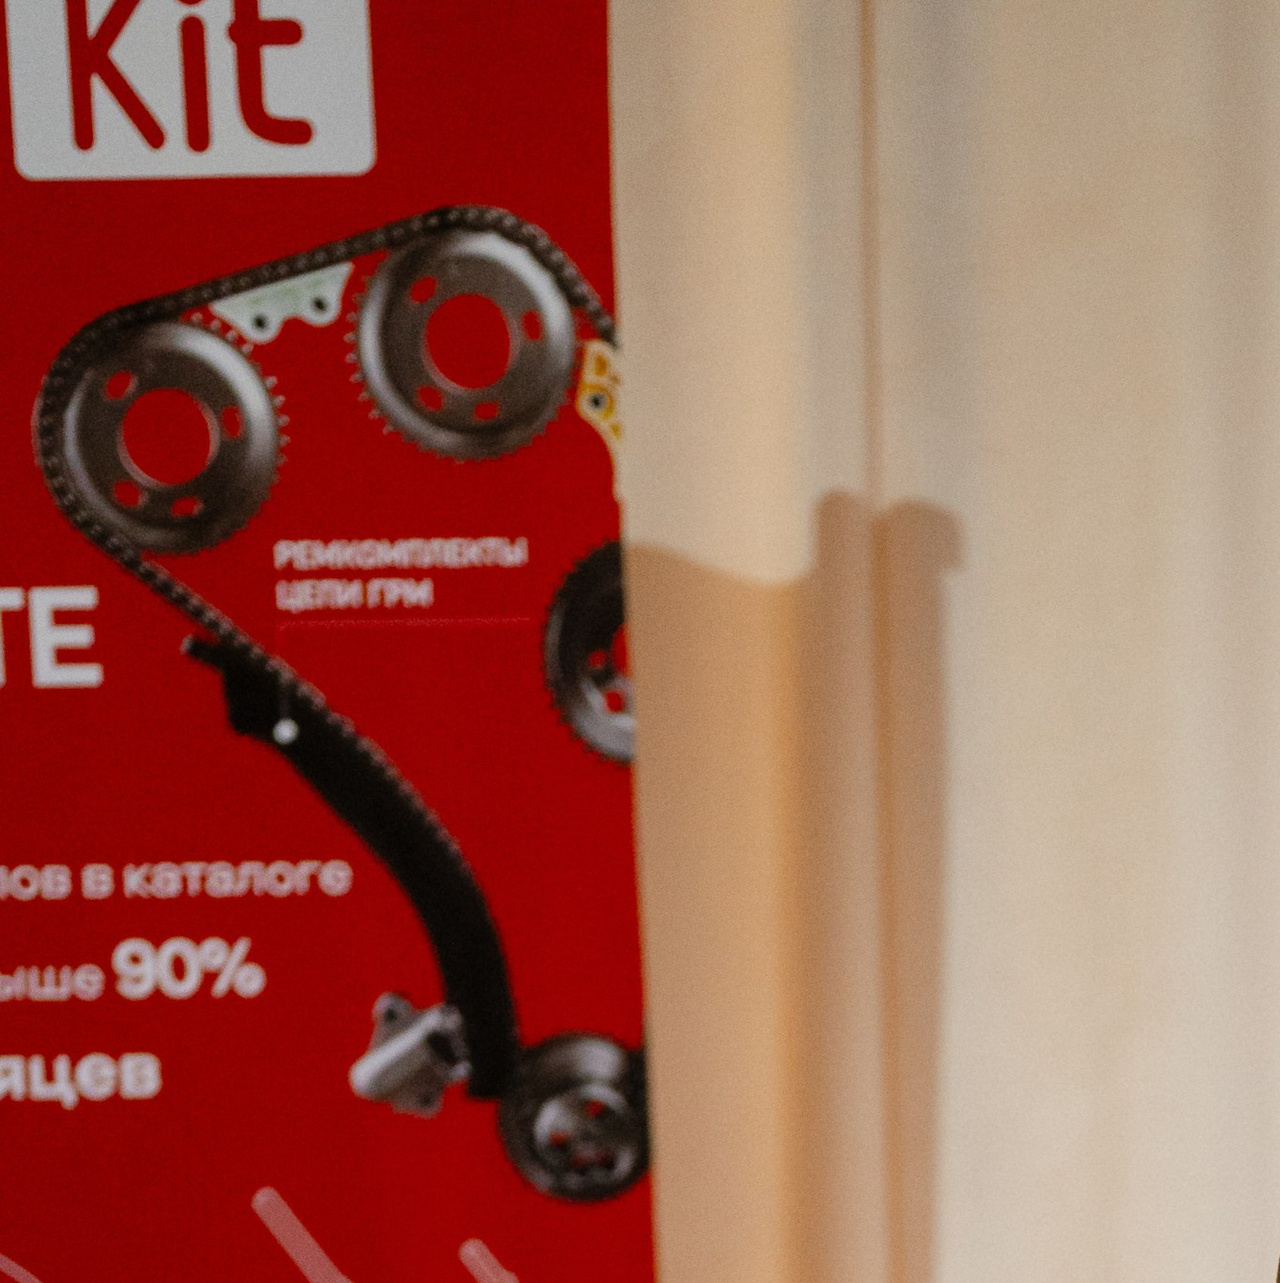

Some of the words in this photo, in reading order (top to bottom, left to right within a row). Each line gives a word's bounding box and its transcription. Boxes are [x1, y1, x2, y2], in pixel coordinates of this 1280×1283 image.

[273, 536, 529, 571] РЕМКОМПЛЕКТЫ
[275, 579, 363, 614] ЦЕПИ
[366, 577, 434, 609] ГРМ
[80, 863, 116, 900] в
[122, 859, 354, 899] каталоге
[111, 936, 267, 1001] 90%
